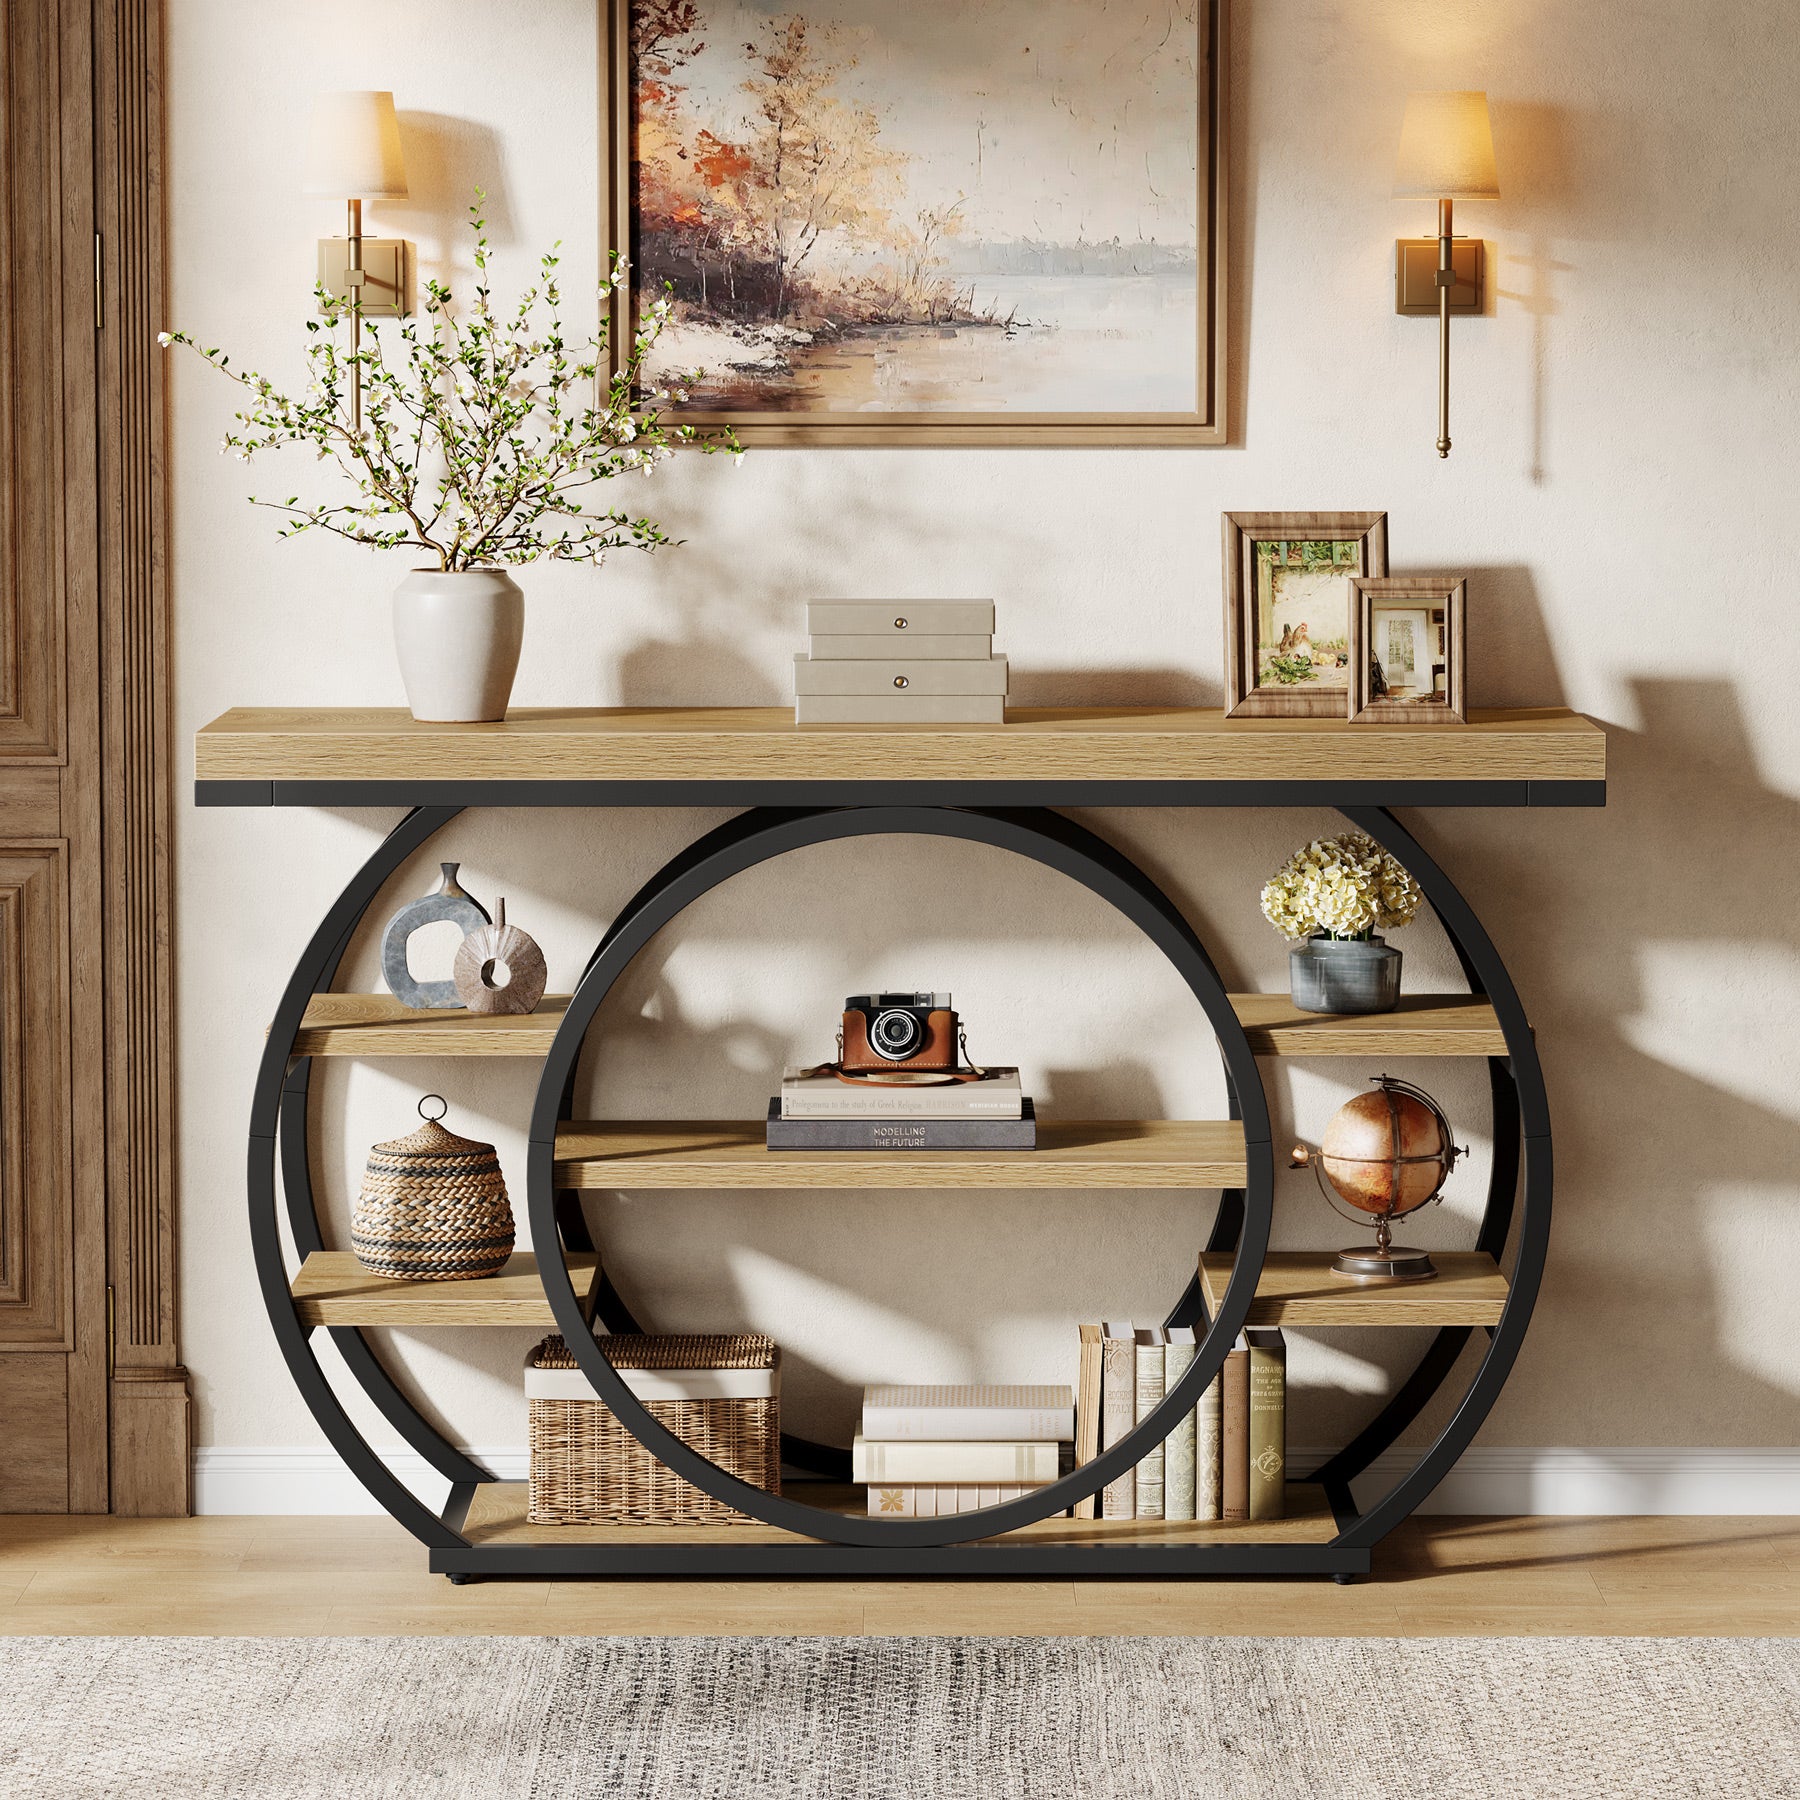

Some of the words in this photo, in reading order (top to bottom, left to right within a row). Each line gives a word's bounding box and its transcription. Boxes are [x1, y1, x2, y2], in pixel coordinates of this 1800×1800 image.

[832, 1100, 839, 1109] to
[841, 1099, 850, 1109] the
[851, 1099, 867, 1112] study
[869, 1099, 876, 1109] of
[877, 1099, 895, 1109] Greek
[873, 1127, 926, 1136] MODELLING
[875, 1138, 890, 1147] THE
[892, 1138, 926, 1147] FUTURE
[1107, 1403, 1132, 1414] ITALY
